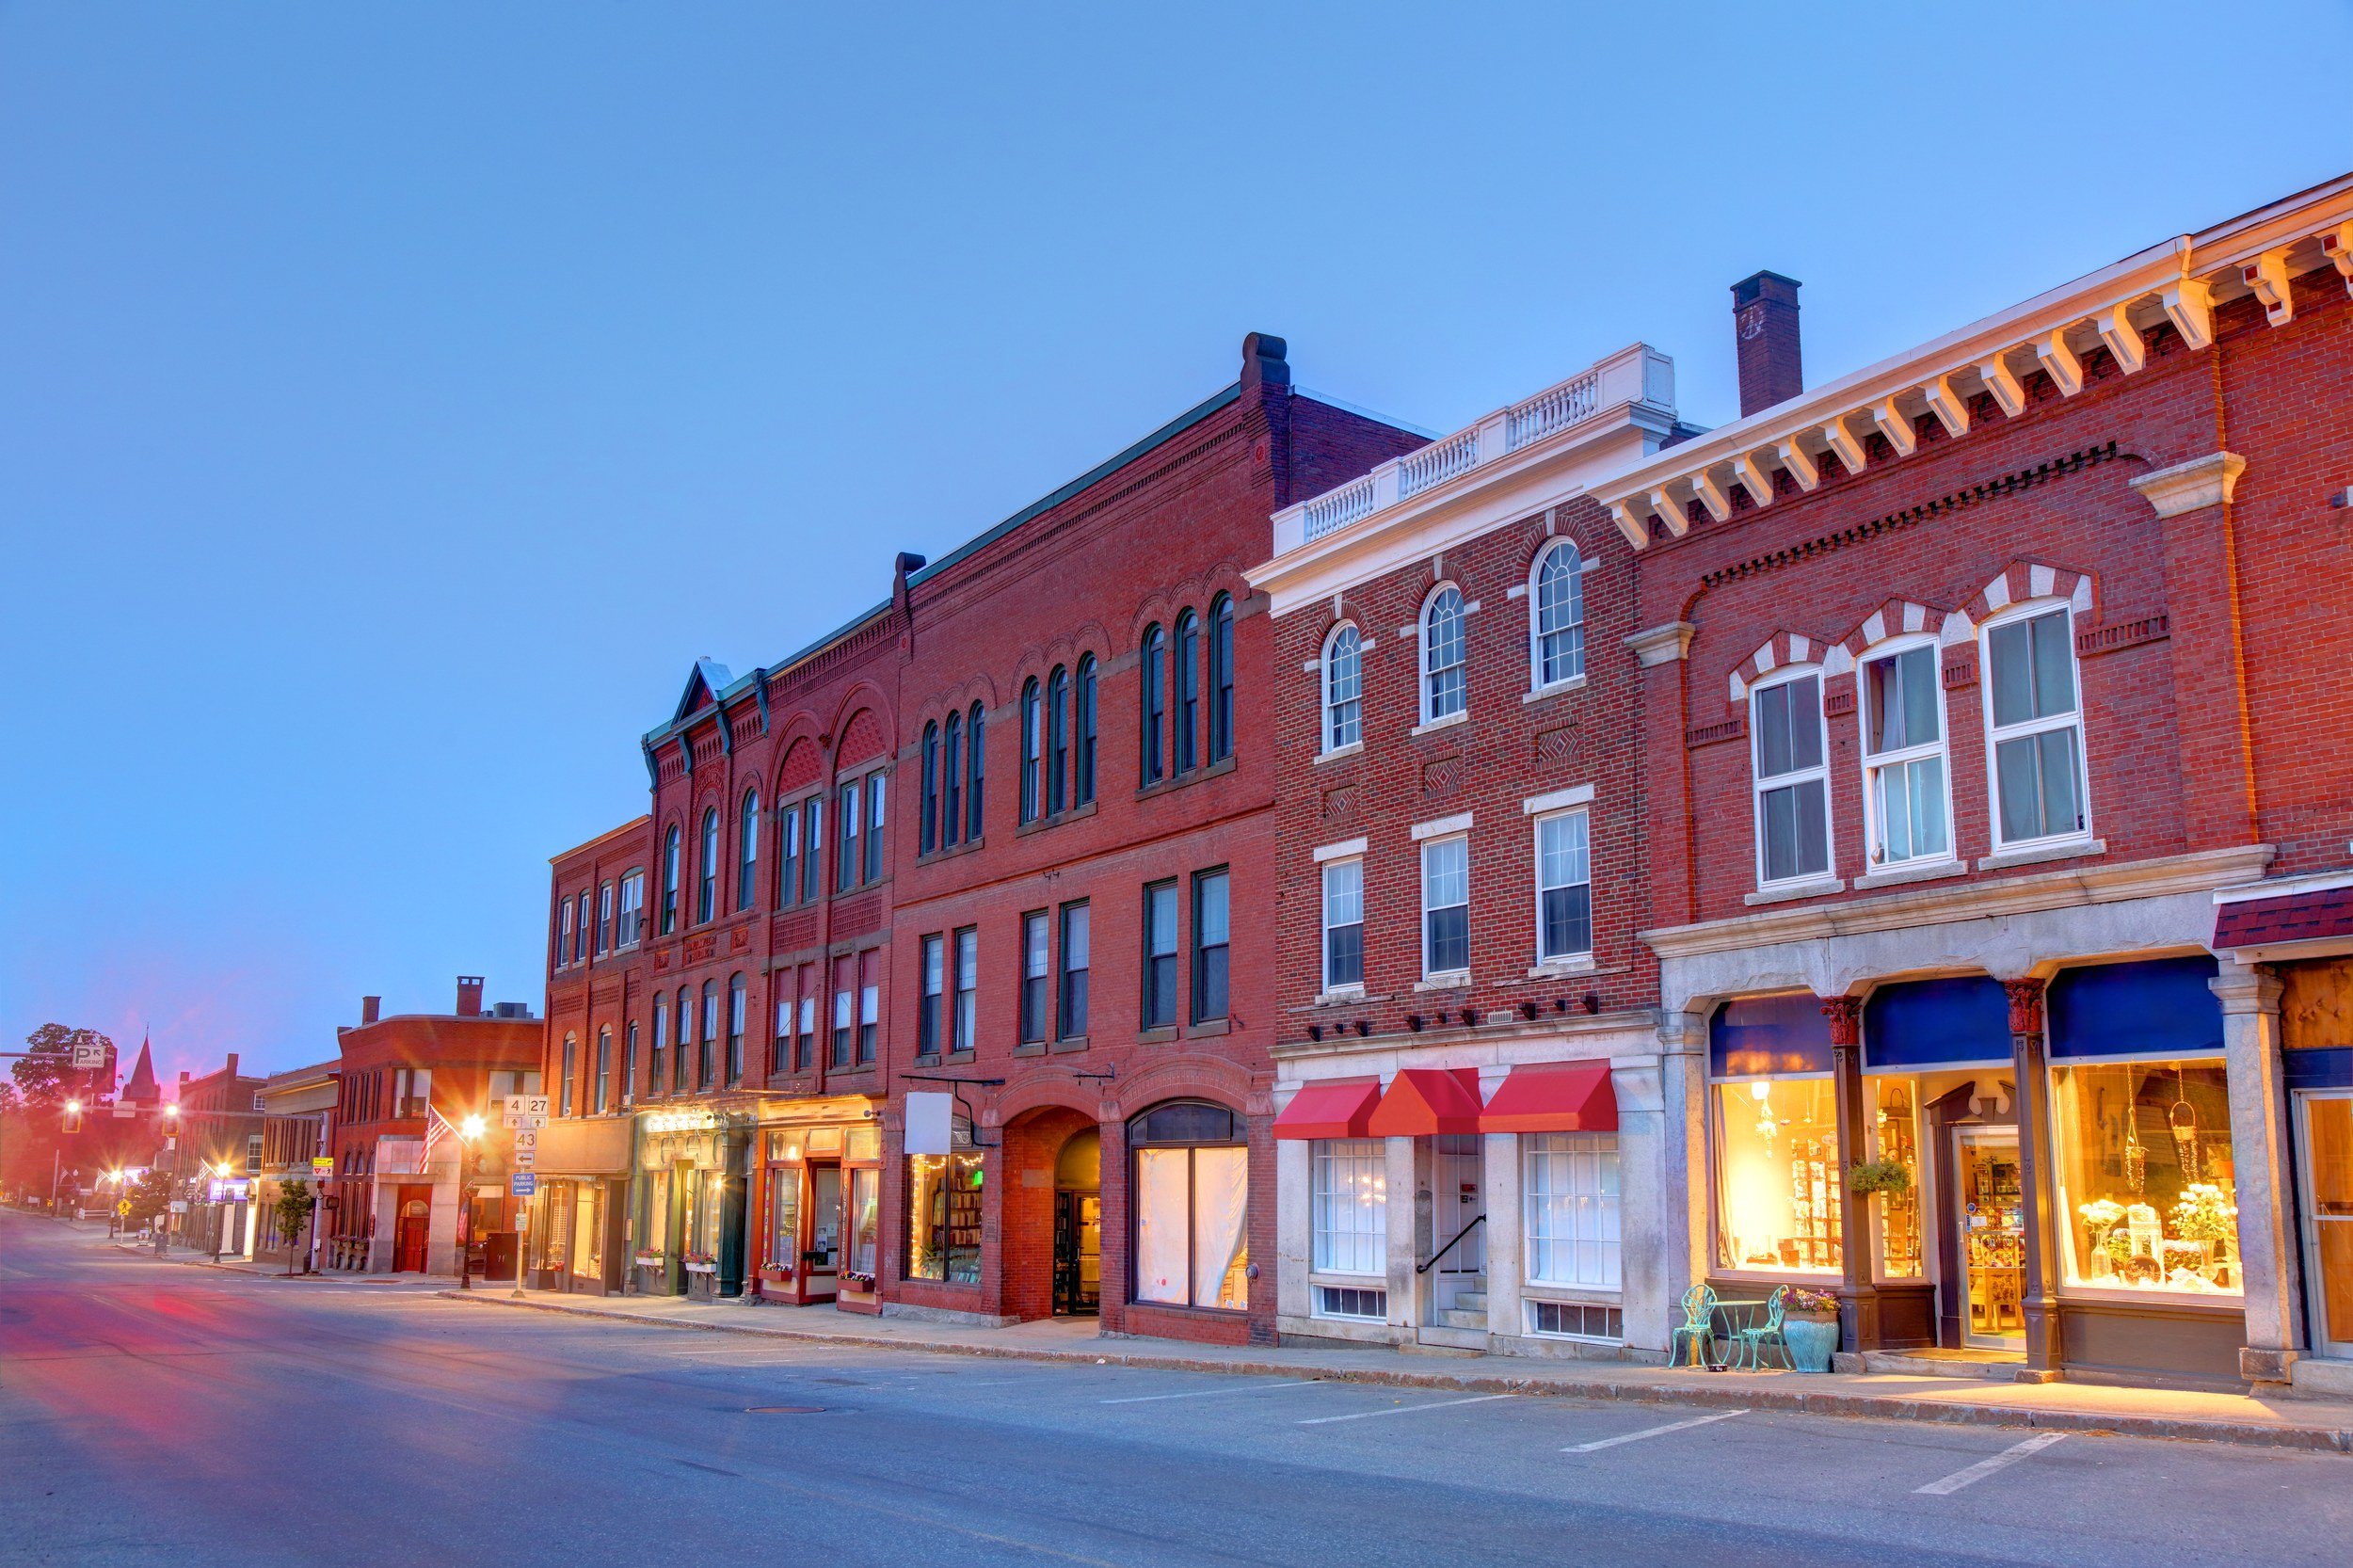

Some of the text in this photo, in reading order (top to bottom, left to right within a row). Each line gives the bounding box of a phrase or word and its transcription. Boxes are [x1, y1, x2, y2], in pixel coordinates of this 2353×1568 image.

[76, 1048, 103, 1064] PARKING
[511, 1100, 519, 1111] 4
[531, 1100, 546, 1111] 27
[517, 1133, 535, 1145] 43
